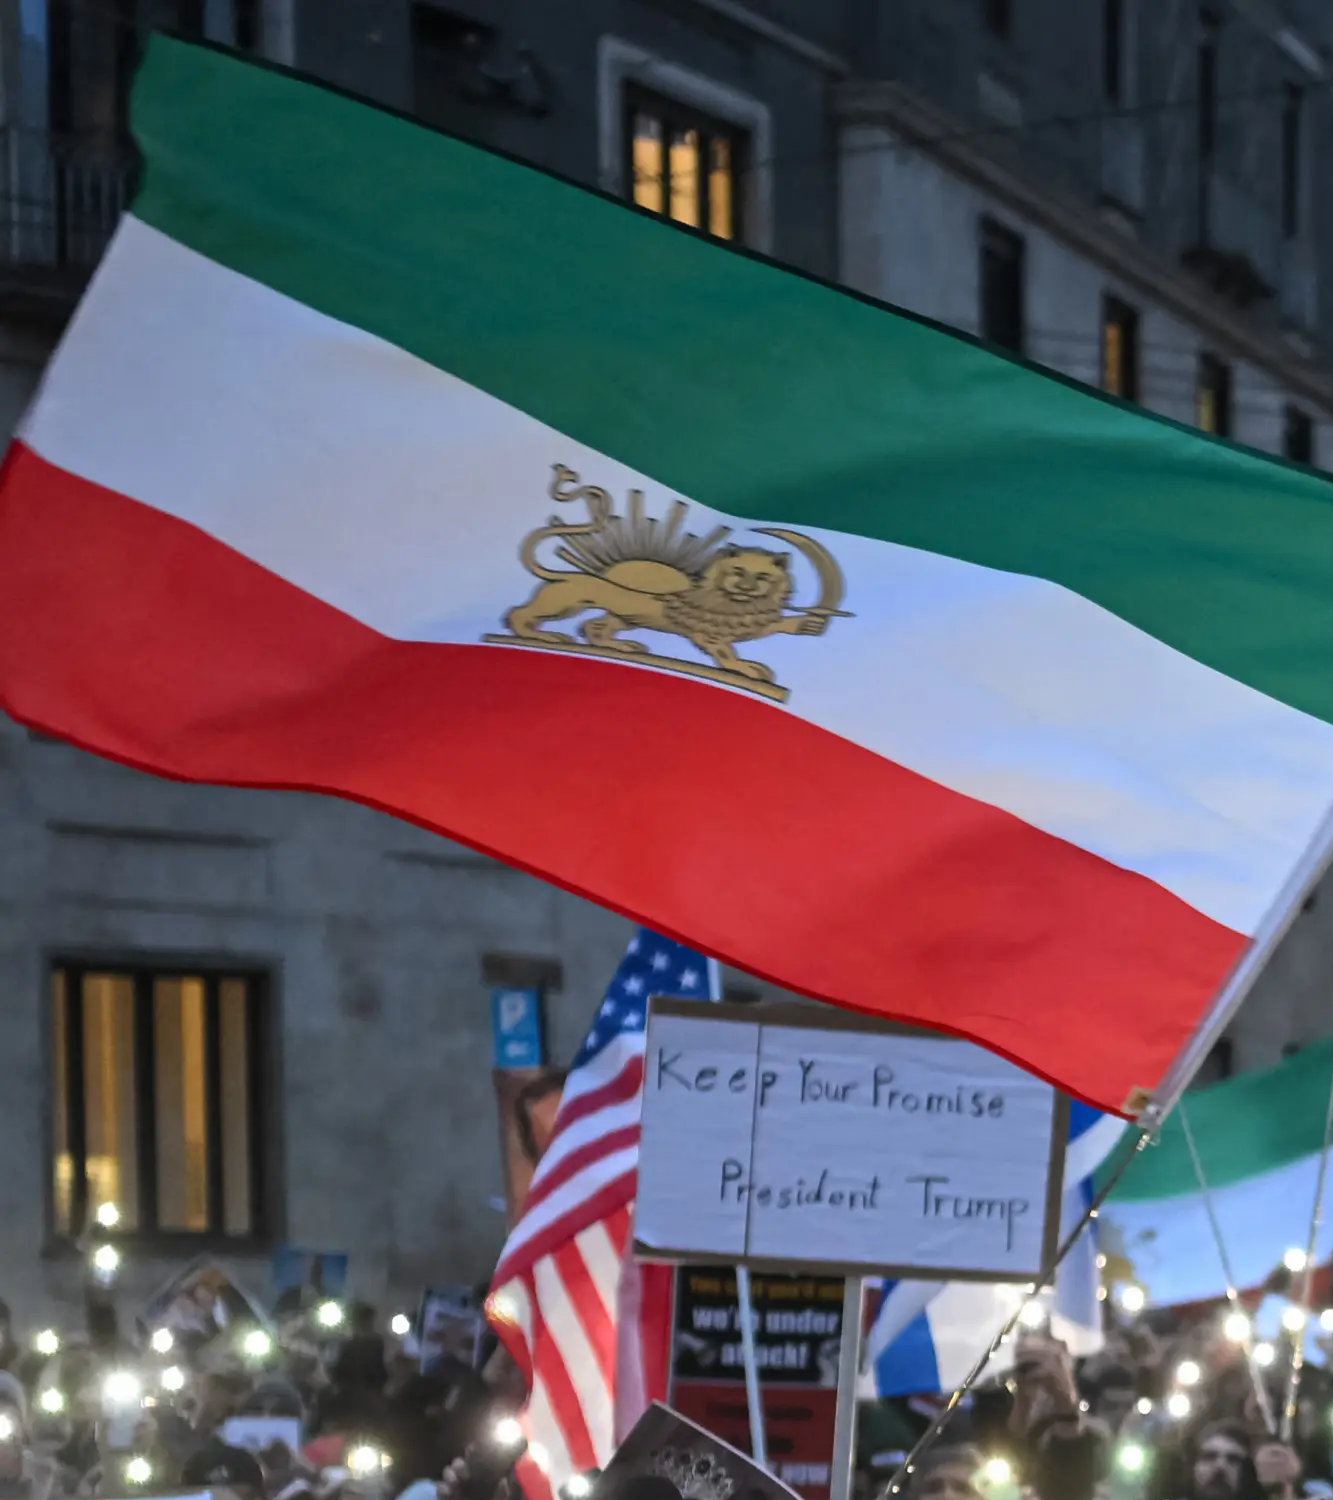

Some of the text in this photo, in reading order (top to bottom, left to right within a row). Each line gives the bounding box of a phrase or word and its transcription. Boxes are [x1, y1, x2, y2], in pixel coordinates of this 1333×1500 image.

[657, 1047, 1007, 1119] Keep Your Promise
[719, 1158, 1031, 1252] President Trump
